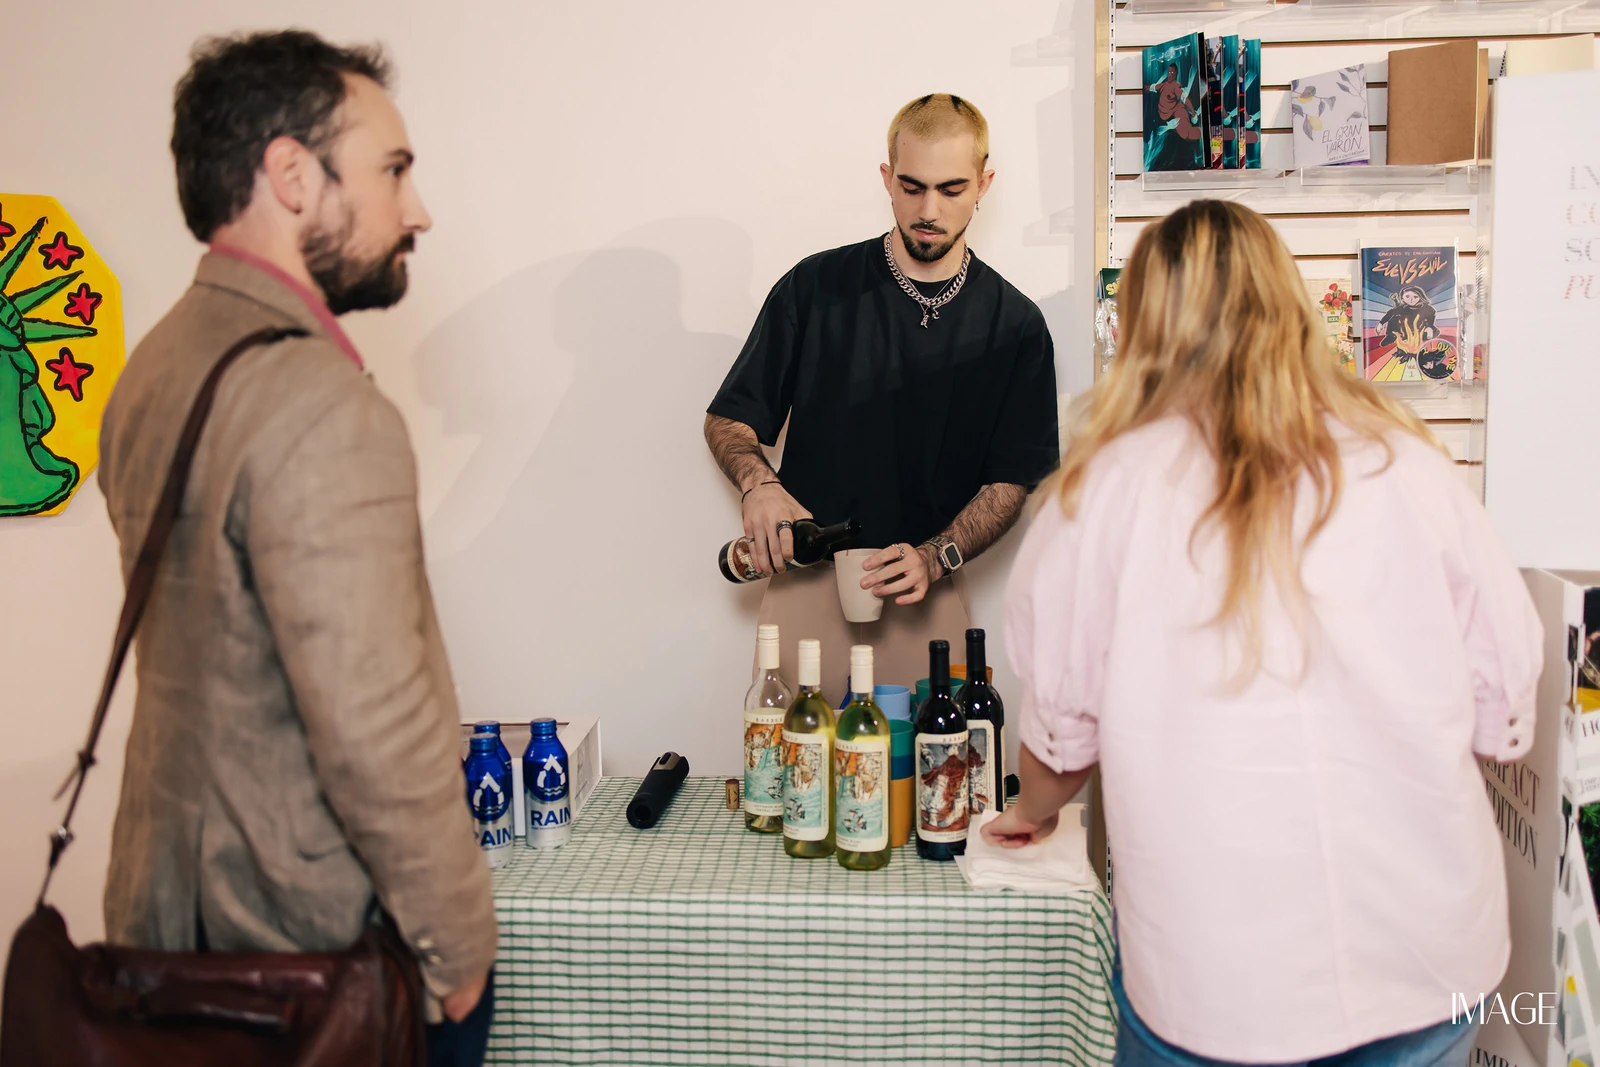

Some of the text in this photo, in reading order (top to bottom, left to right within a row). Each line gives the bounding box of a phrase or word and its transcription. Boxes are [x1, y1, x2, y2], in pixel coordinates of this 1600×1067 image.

[1322, 122, 1363, 143] EL GRAN
[1326, 136, 1362, 155] VARON
[1431, 341, 1453, 356] LOVE
[1486, 761, 1540, 816] PACT
[476, 825, 512, 847] AIN
[1475, 1047, 1518, 1067] IMP
